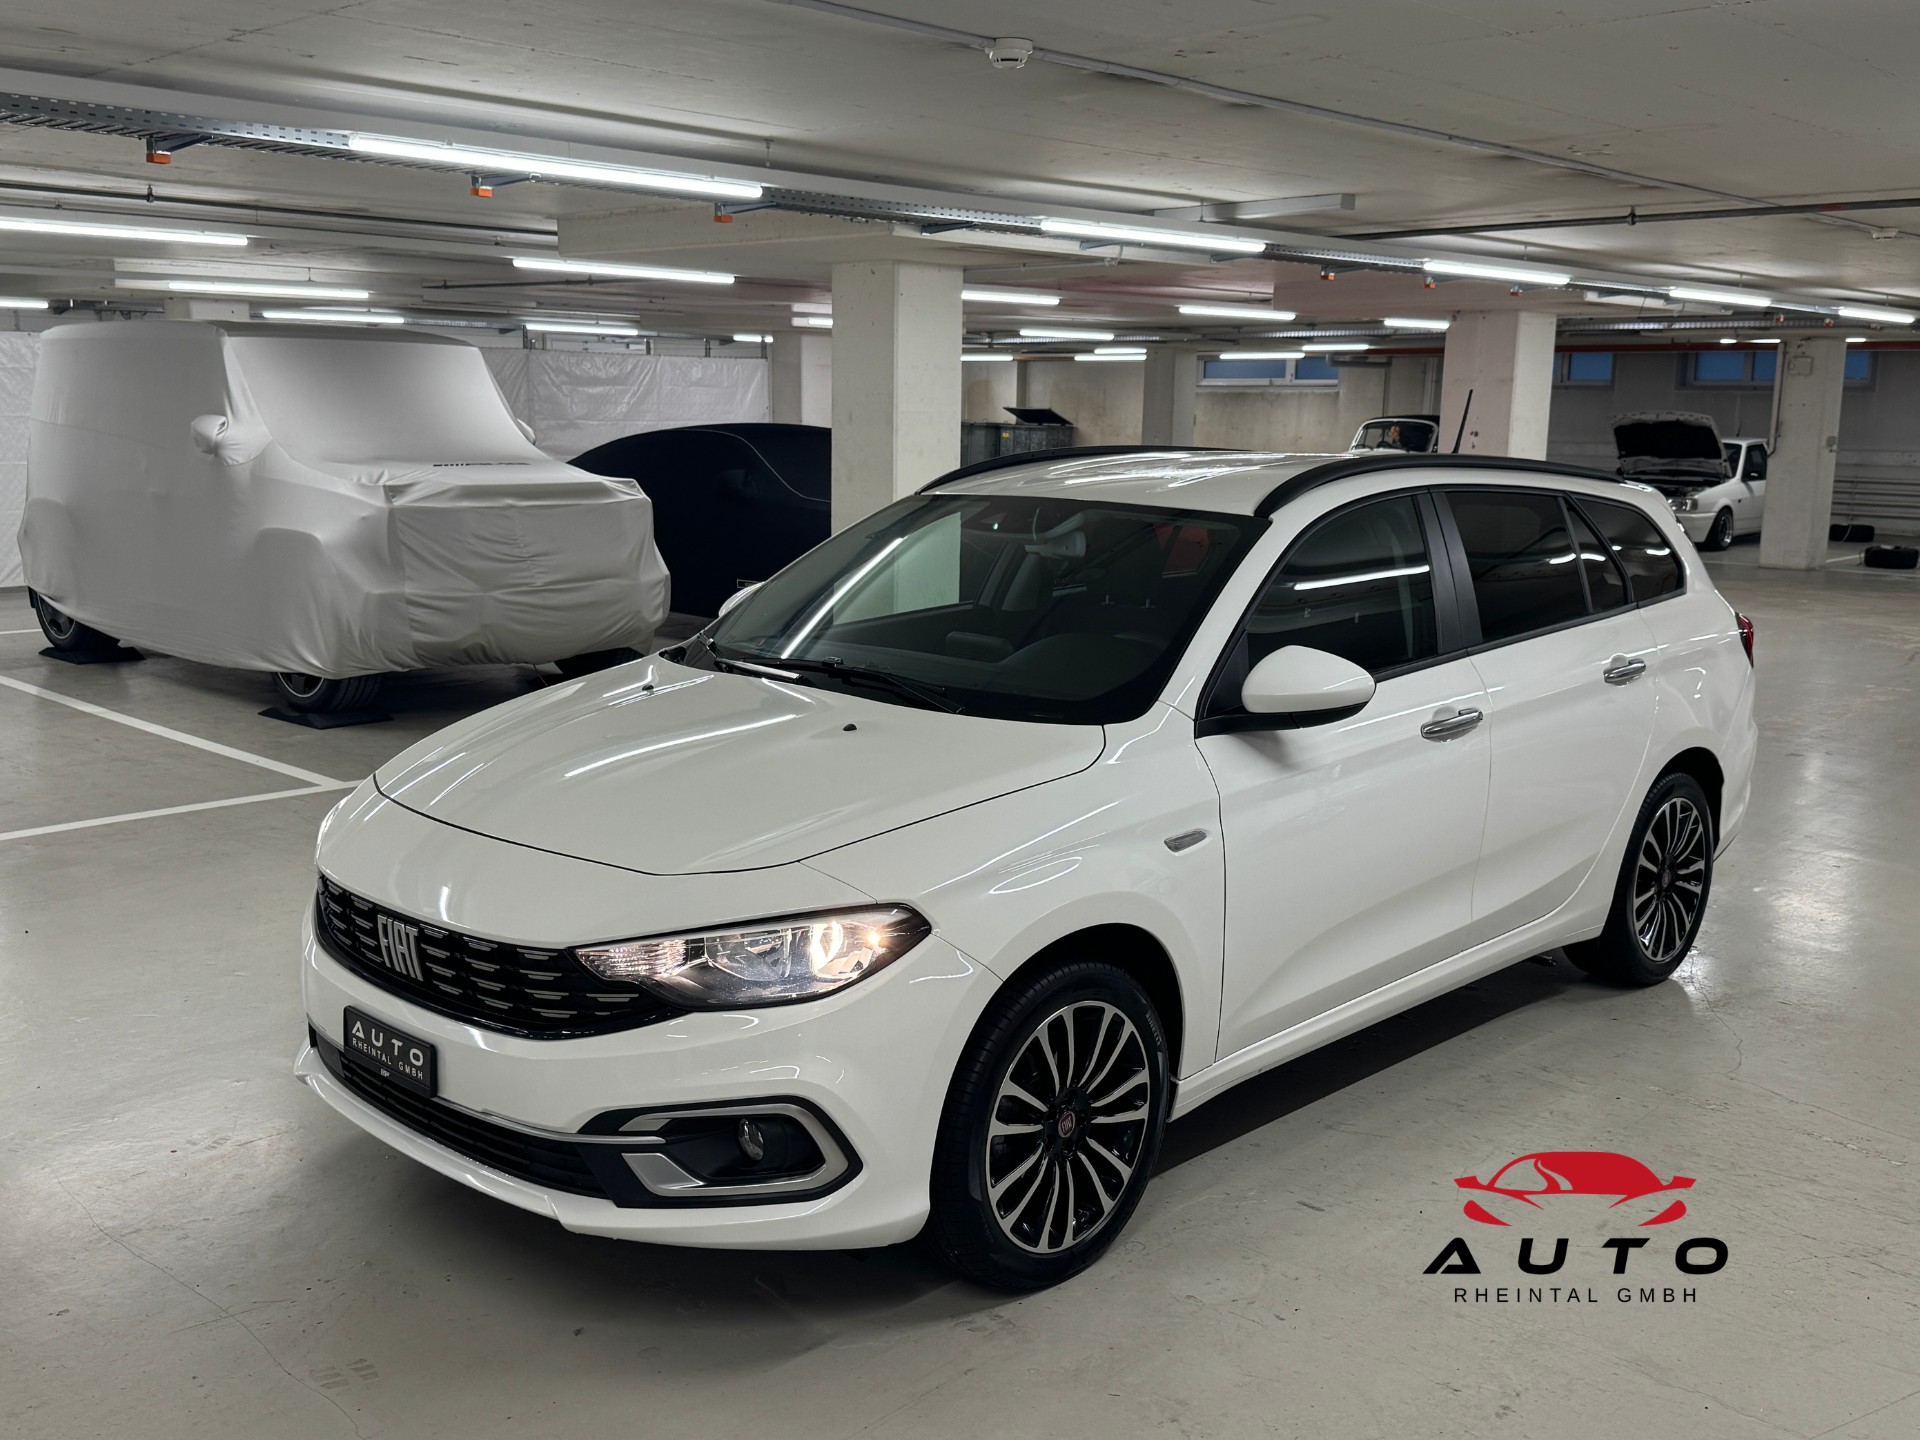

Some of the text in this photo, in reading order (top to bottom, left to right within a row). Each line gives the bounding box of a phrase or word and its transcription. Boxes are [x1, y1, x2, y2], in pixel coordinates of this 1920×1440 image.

[377, 914, 424, 981] FIAT
[351, 1020, 424, 1067] AUTO
[352, 1037, 423, 1080] RHEINTAL GMBH
